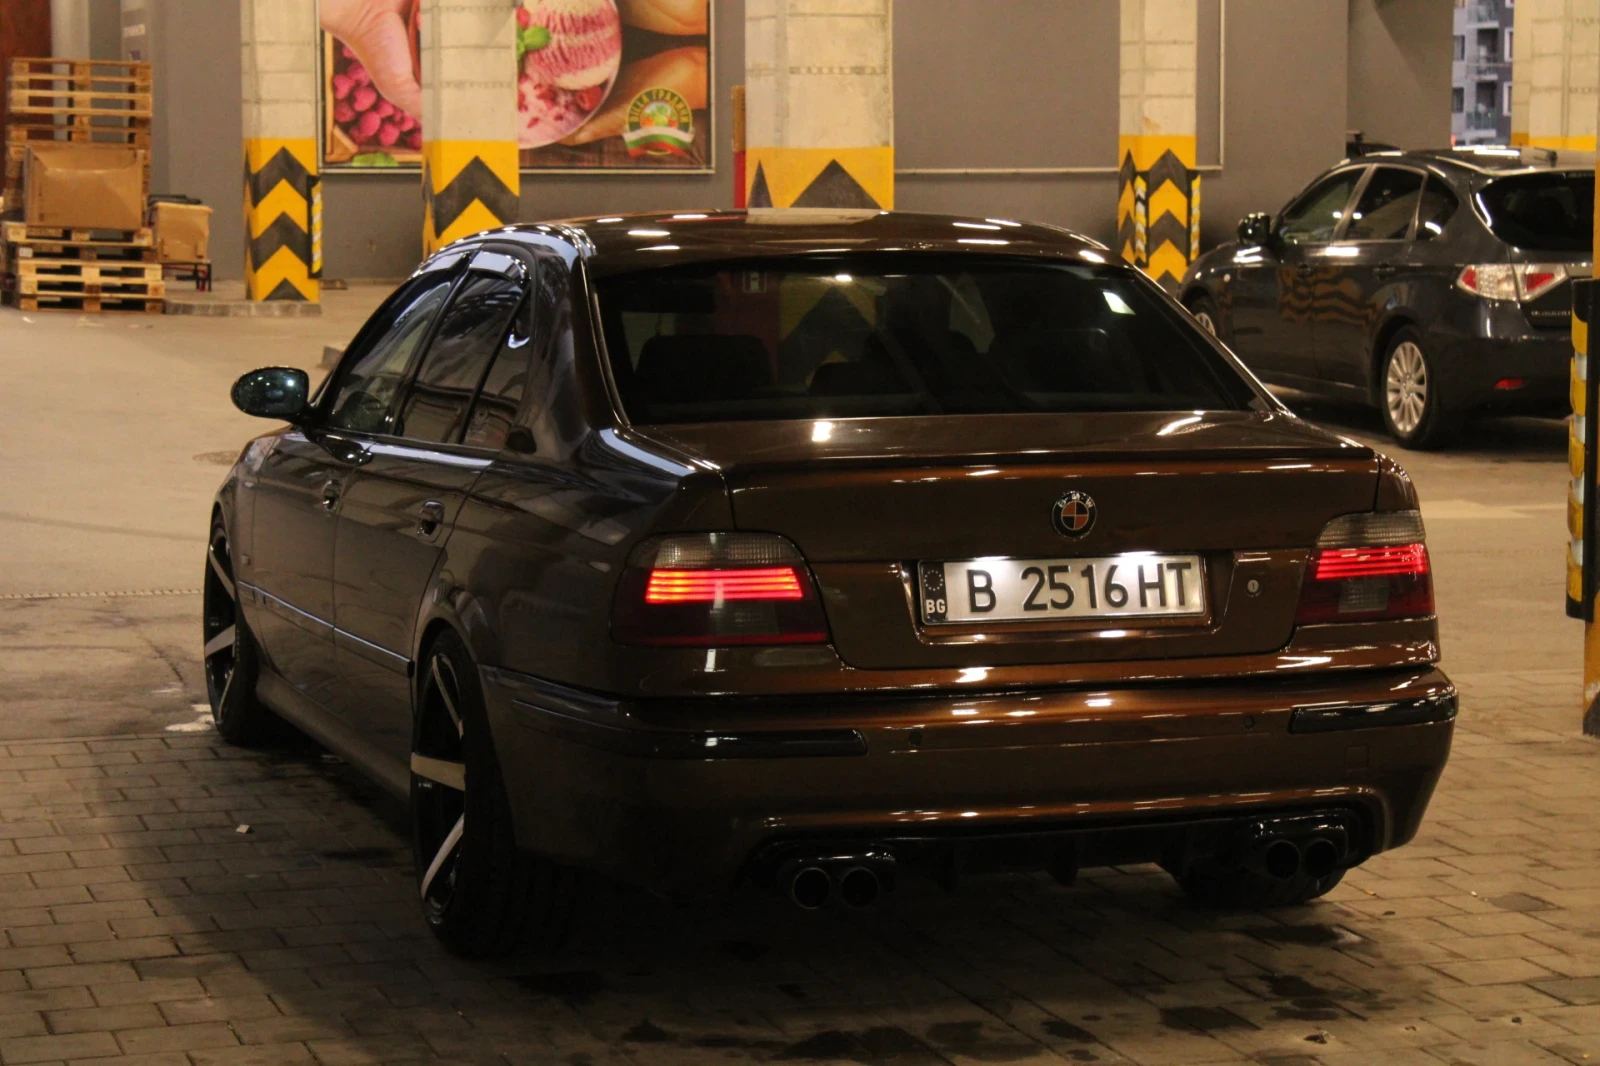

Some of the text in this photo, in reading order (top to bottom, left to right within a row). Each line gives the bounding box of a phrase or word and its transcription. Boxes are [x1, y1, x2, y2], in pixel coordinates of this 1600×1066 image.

[1057, 493, 1094, 509] BMW
[967, 569, 997, 613] B
[925, 598, 946, 614] BG
